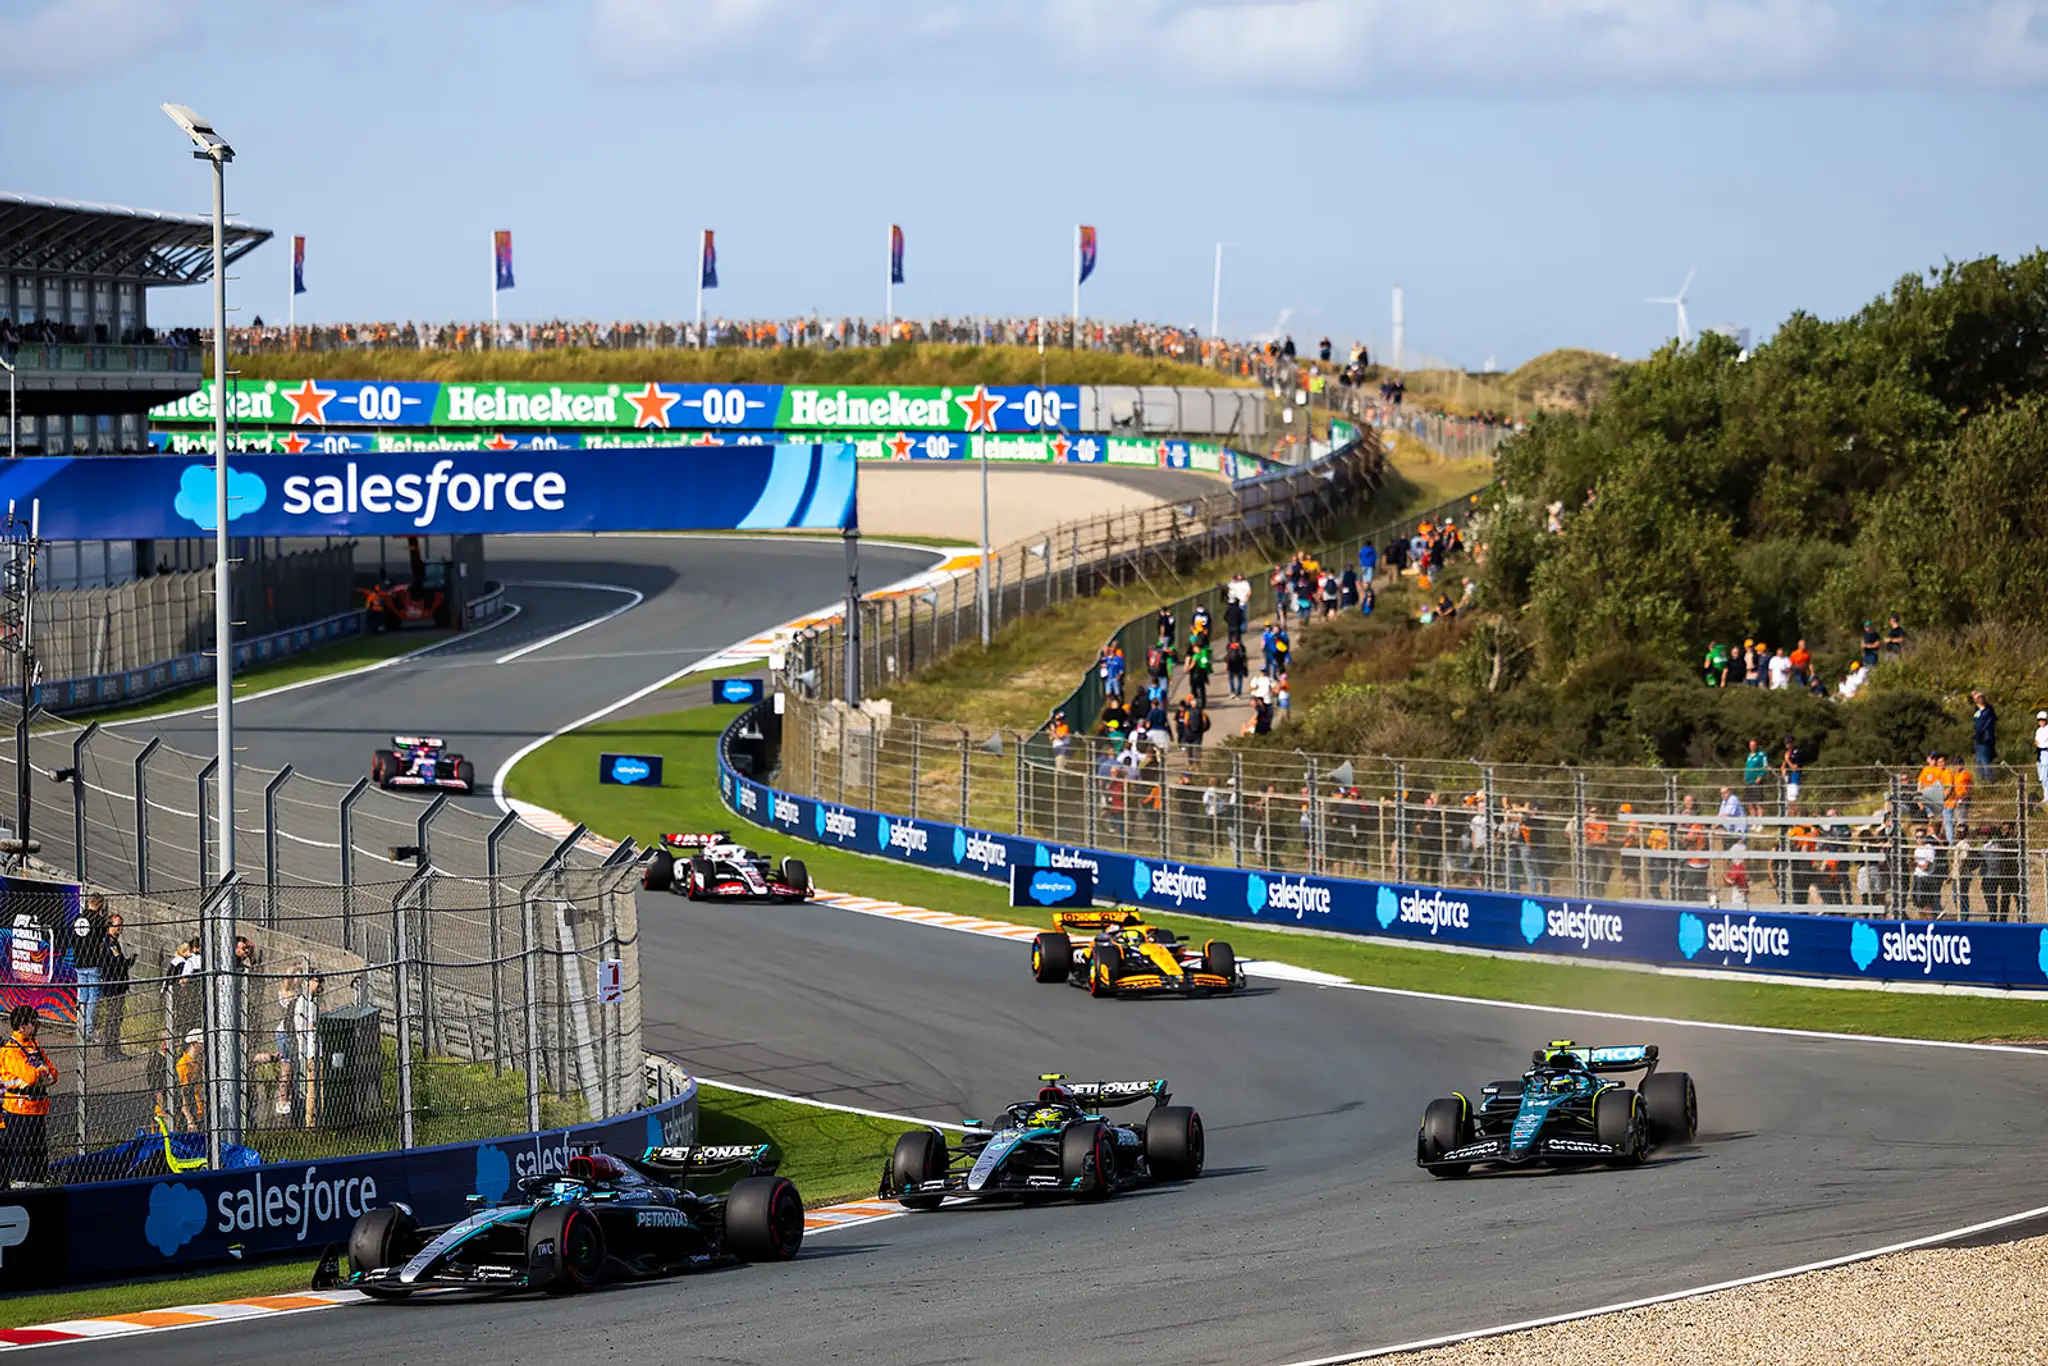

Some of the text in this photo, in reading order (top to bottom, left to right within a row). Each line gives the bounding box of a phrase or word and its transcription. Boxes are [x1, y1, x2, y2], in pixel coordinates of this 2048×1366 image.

[358, 386, 401, 421] 0.0
[447, 386, 745, 424] Heineken 0.0
[791, 389, 1061, 426] Heineken 00
[283, 460, 566, 527] salesforce
[966, 834, 1006, 872] salesforce
[1152, 866, 1207, 906] salesforce
[1268, 876, 1331, 919] salesforce
[1400, 886, 1470, 935] salesforce
[1547, 903, 1623, 949] salesforce
[1707, 914, 1790, 965] salesforce
[1882, 923, 1972, 974] salesforce
[1548, 1139, 1613, 1153] aramco
[218, 1166, 377, 1240] salesforce
[637, 1211, 689, 1227] PETRONAS
[537, 1243, 554, 1256] IWC
